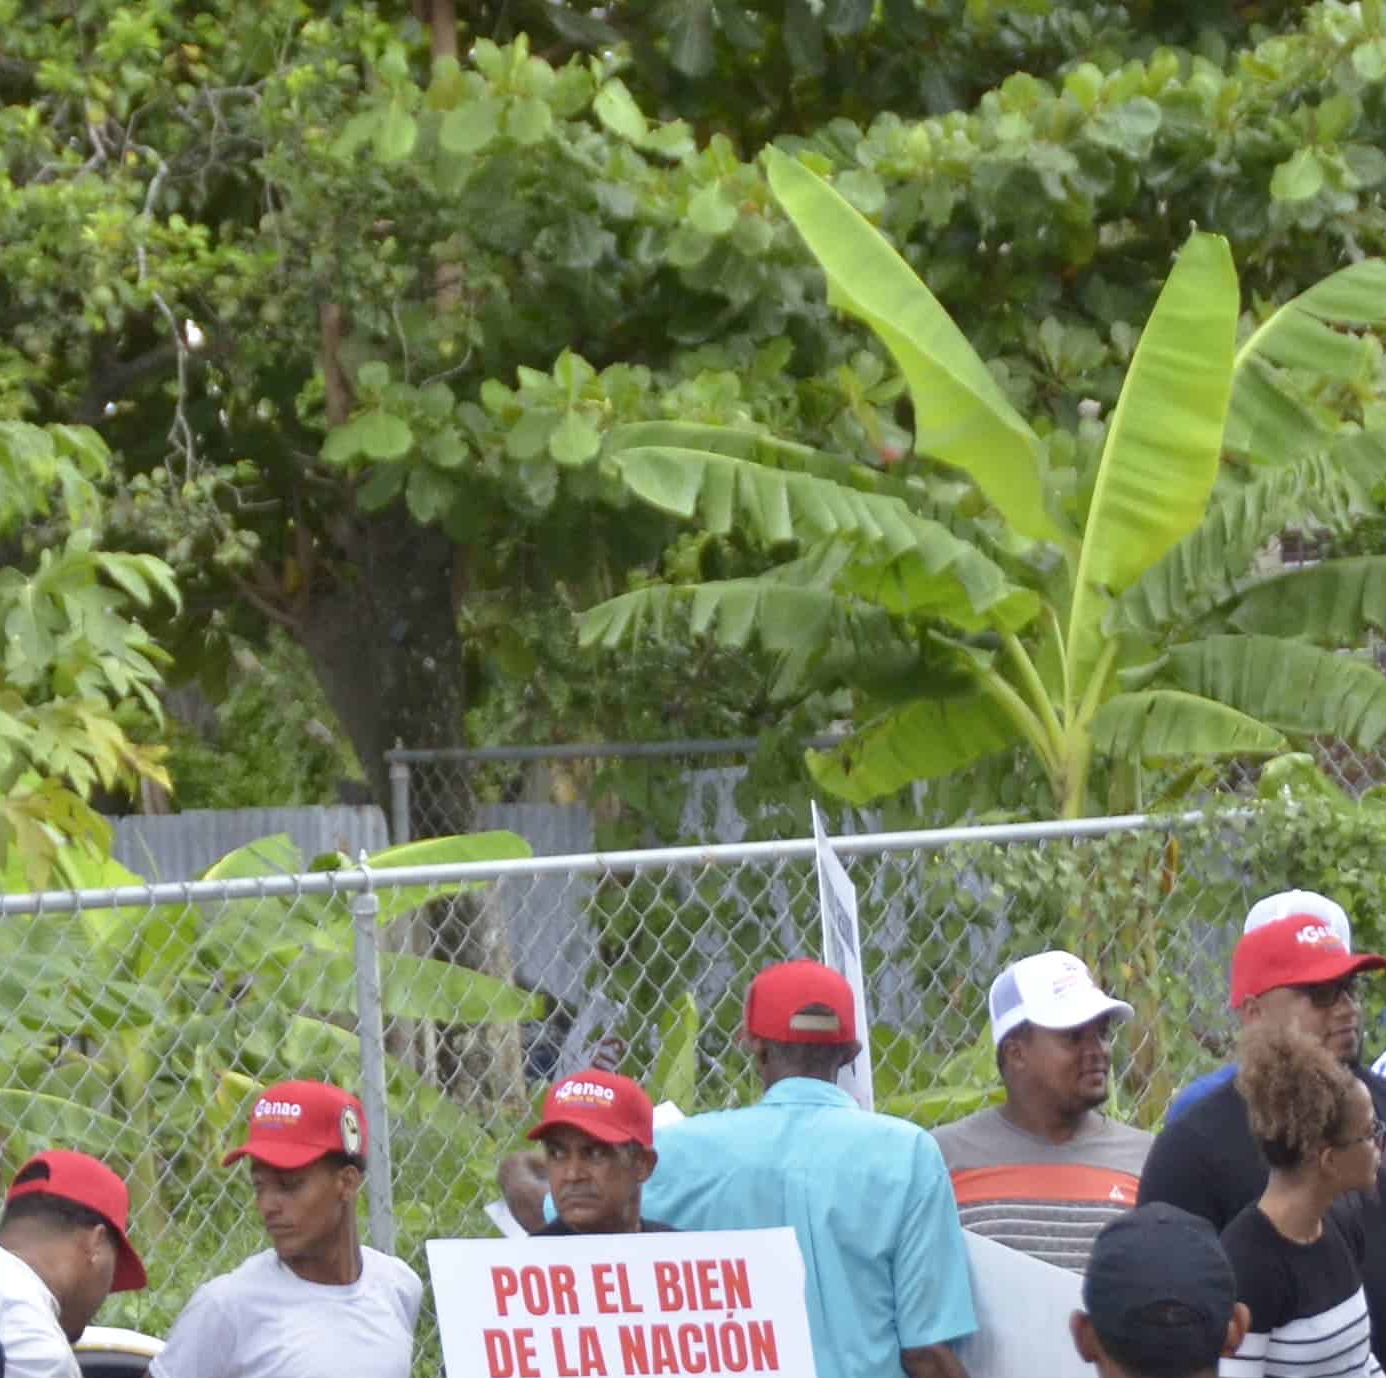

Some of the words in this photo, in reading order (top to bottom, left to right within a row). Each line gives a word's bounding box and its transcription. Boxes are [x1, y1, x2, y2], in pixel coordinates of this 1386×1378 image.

[491, 1264, 580, 1317] POR
[591, 1262, 644, 1315] EL
[653, 1258, 753, 1314] BIEN
[551, 1325, 609, 1378] LA
[618, 1310, 780, 1377] NACIÓN
